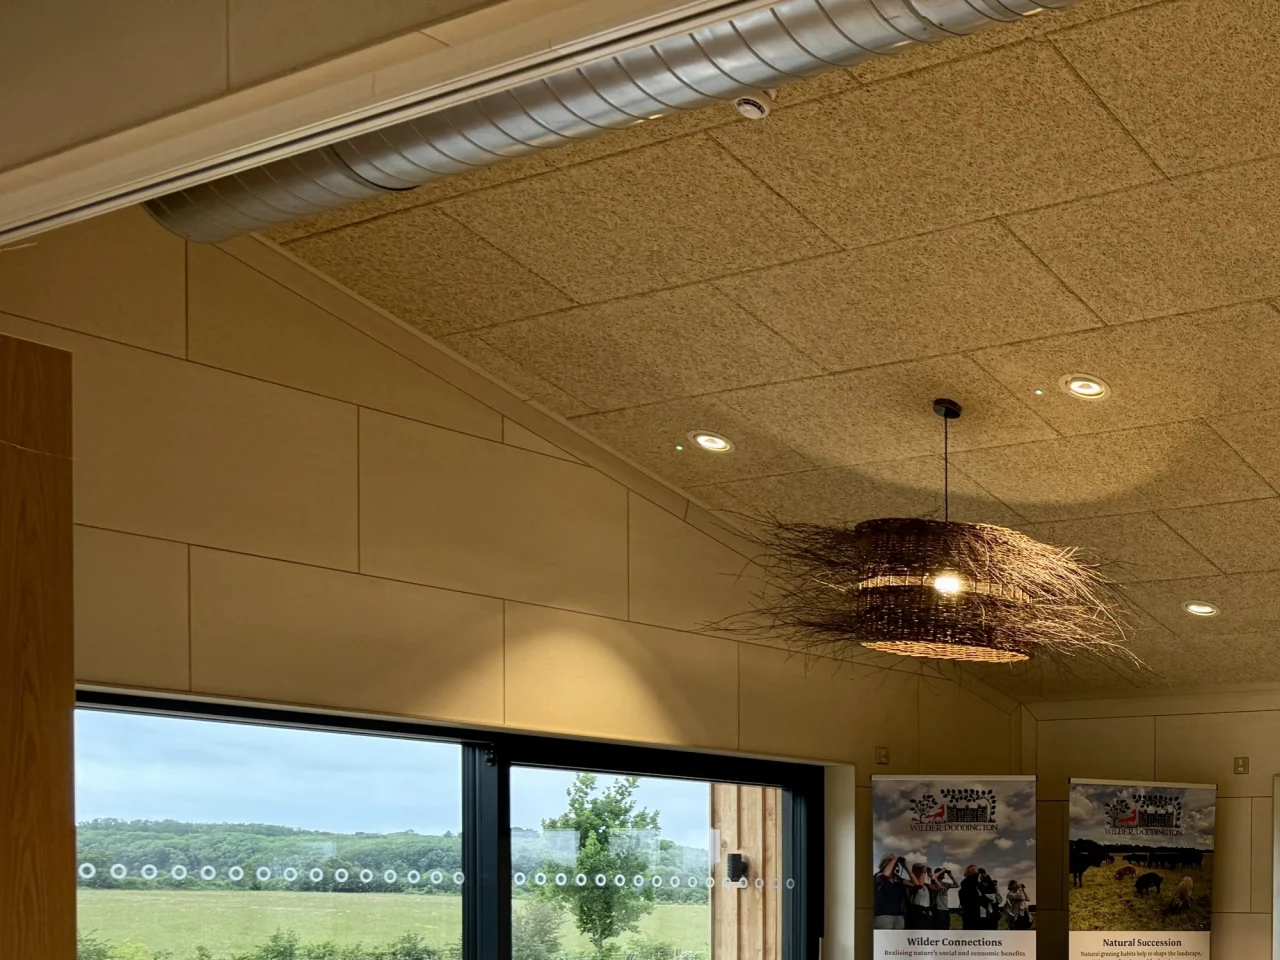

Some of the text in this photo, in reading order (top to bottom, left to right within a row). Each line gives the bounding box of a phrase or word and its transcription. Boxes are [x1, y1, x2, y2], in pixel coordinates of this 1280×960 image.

[910, 824, 998, 832] WILDER DODDINGTON
[907, 937, 1003, 947] Wilder Connections
[1103, 938, 1182, 947] Natural Succession
[884, 949, 913, 957] Realising
